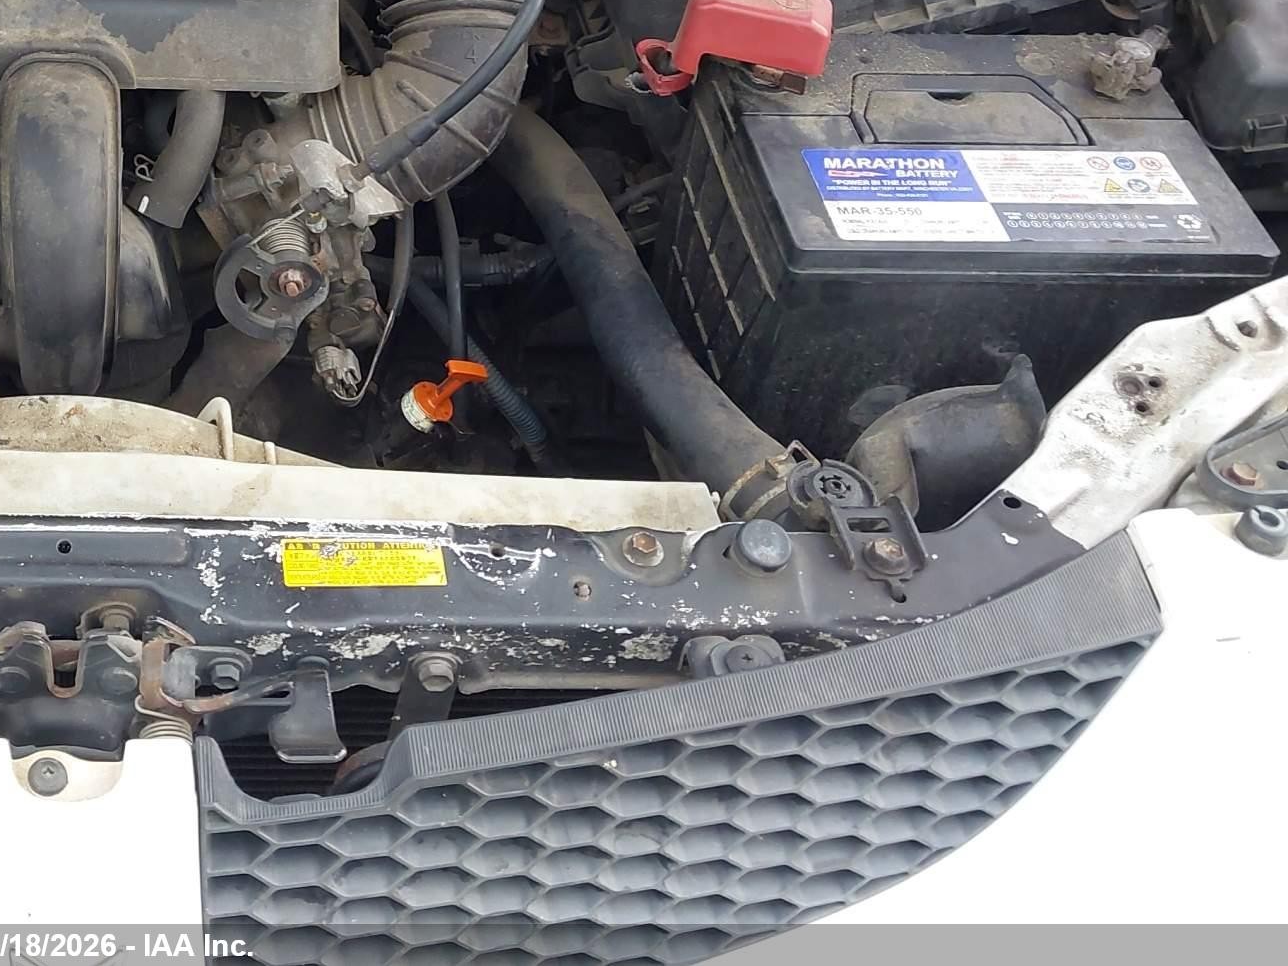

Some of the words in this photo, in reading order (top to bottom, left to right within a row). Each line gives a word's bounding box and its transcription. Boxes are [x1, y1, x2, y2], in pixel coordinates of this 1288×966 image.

[824, 157, 945, 170] MARATHON
[895, 170, 959, 179] BATTERY
[836, 206, 923, 216] MAR-35-550
